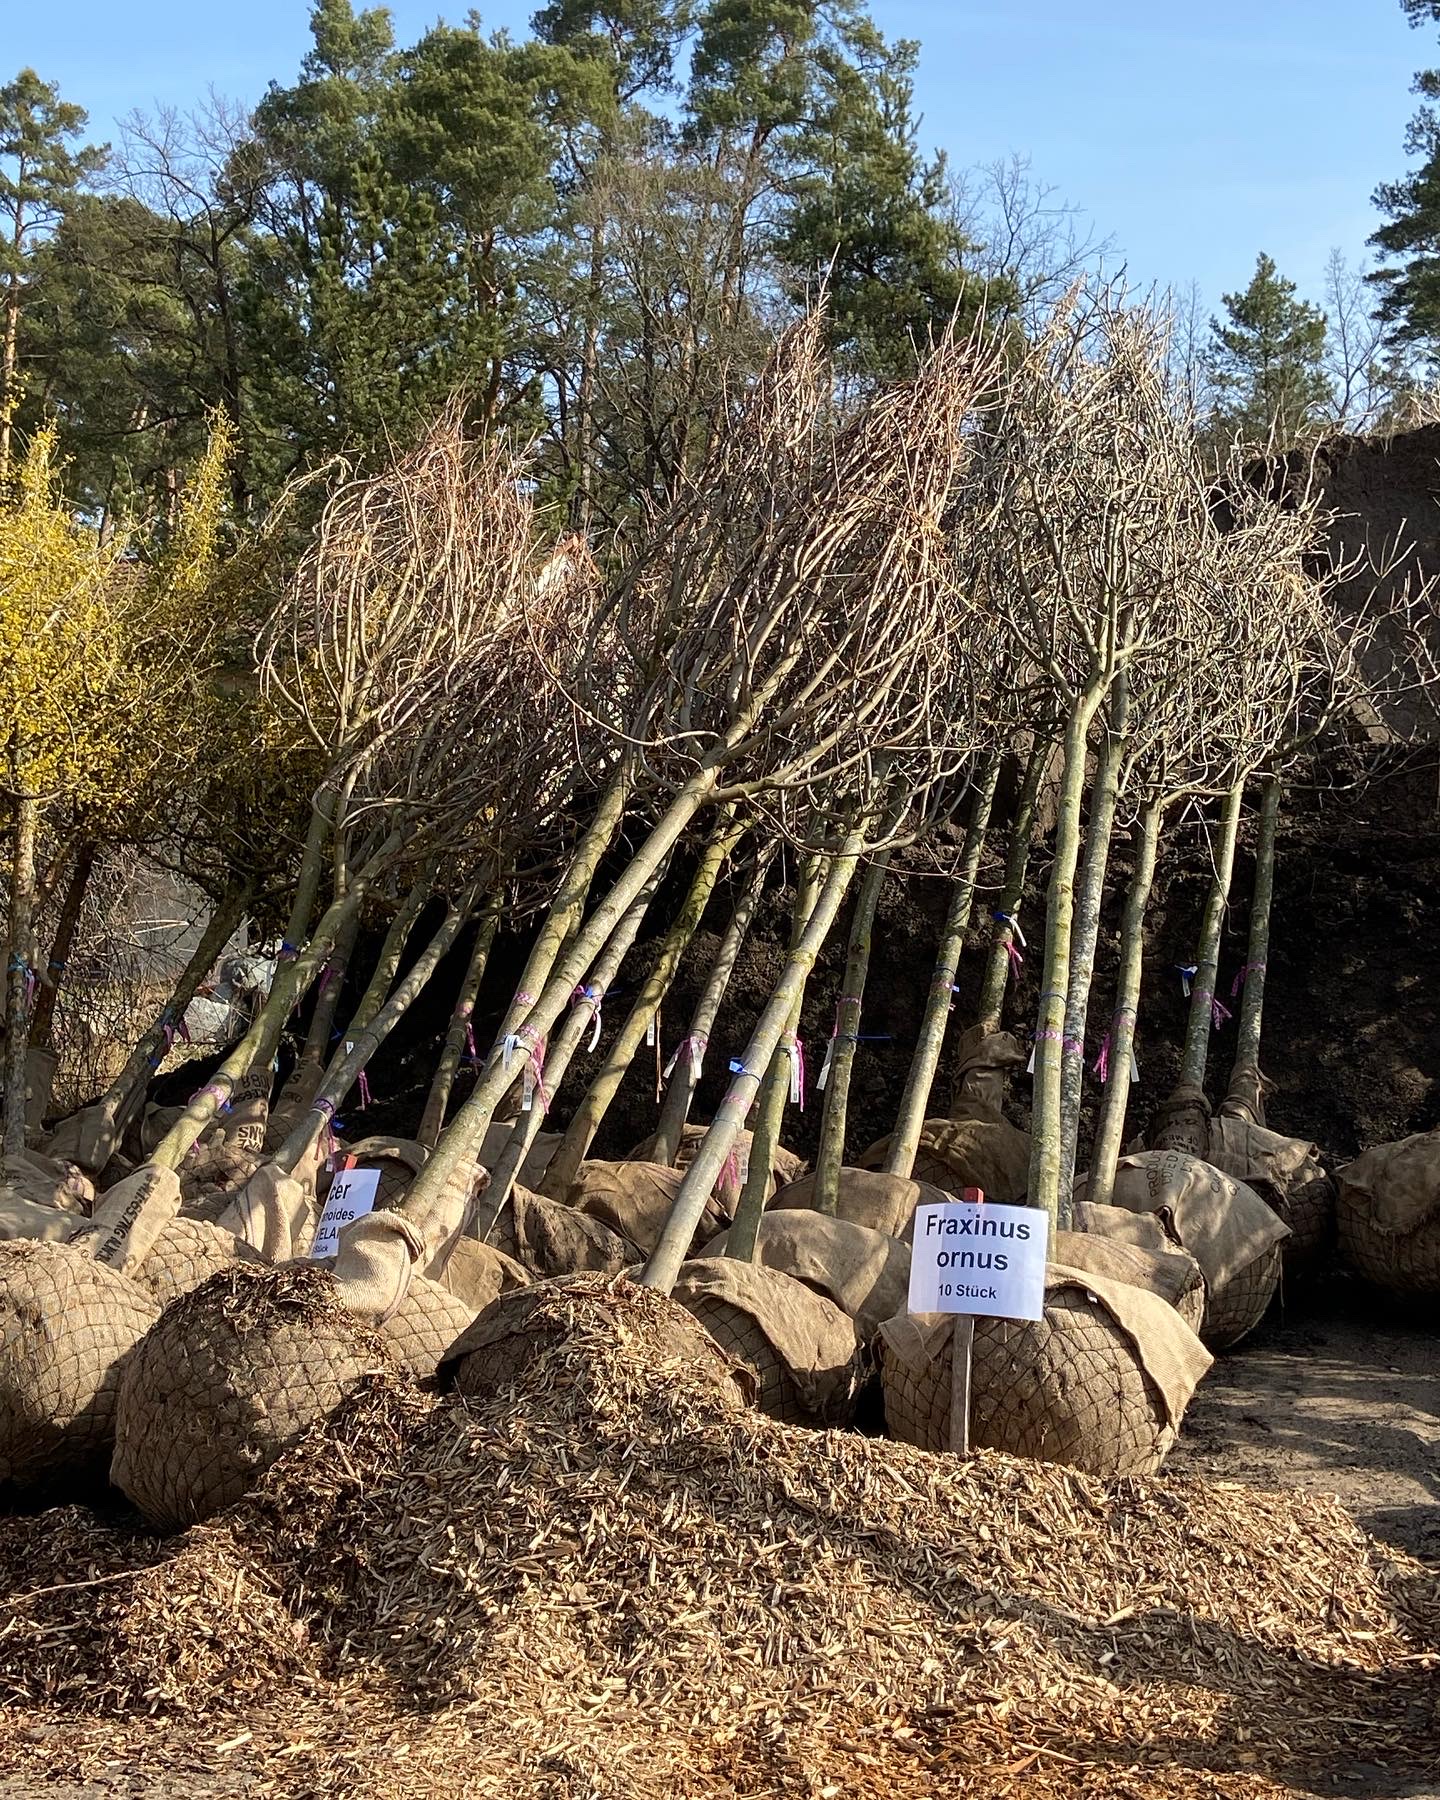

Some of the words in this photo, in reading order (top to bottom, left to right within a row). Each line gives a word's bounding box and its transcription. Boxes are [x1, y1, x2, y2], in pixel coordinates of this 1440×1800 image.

[328, 1183, 352, 1201] cer
[926, 1214, 1031, 1240] Fraxinus
[936, 1250, 1009, 1271] ornus
[938, 1284, 952, 1297] 10
[956, 1284, 998, 1300] Stück
